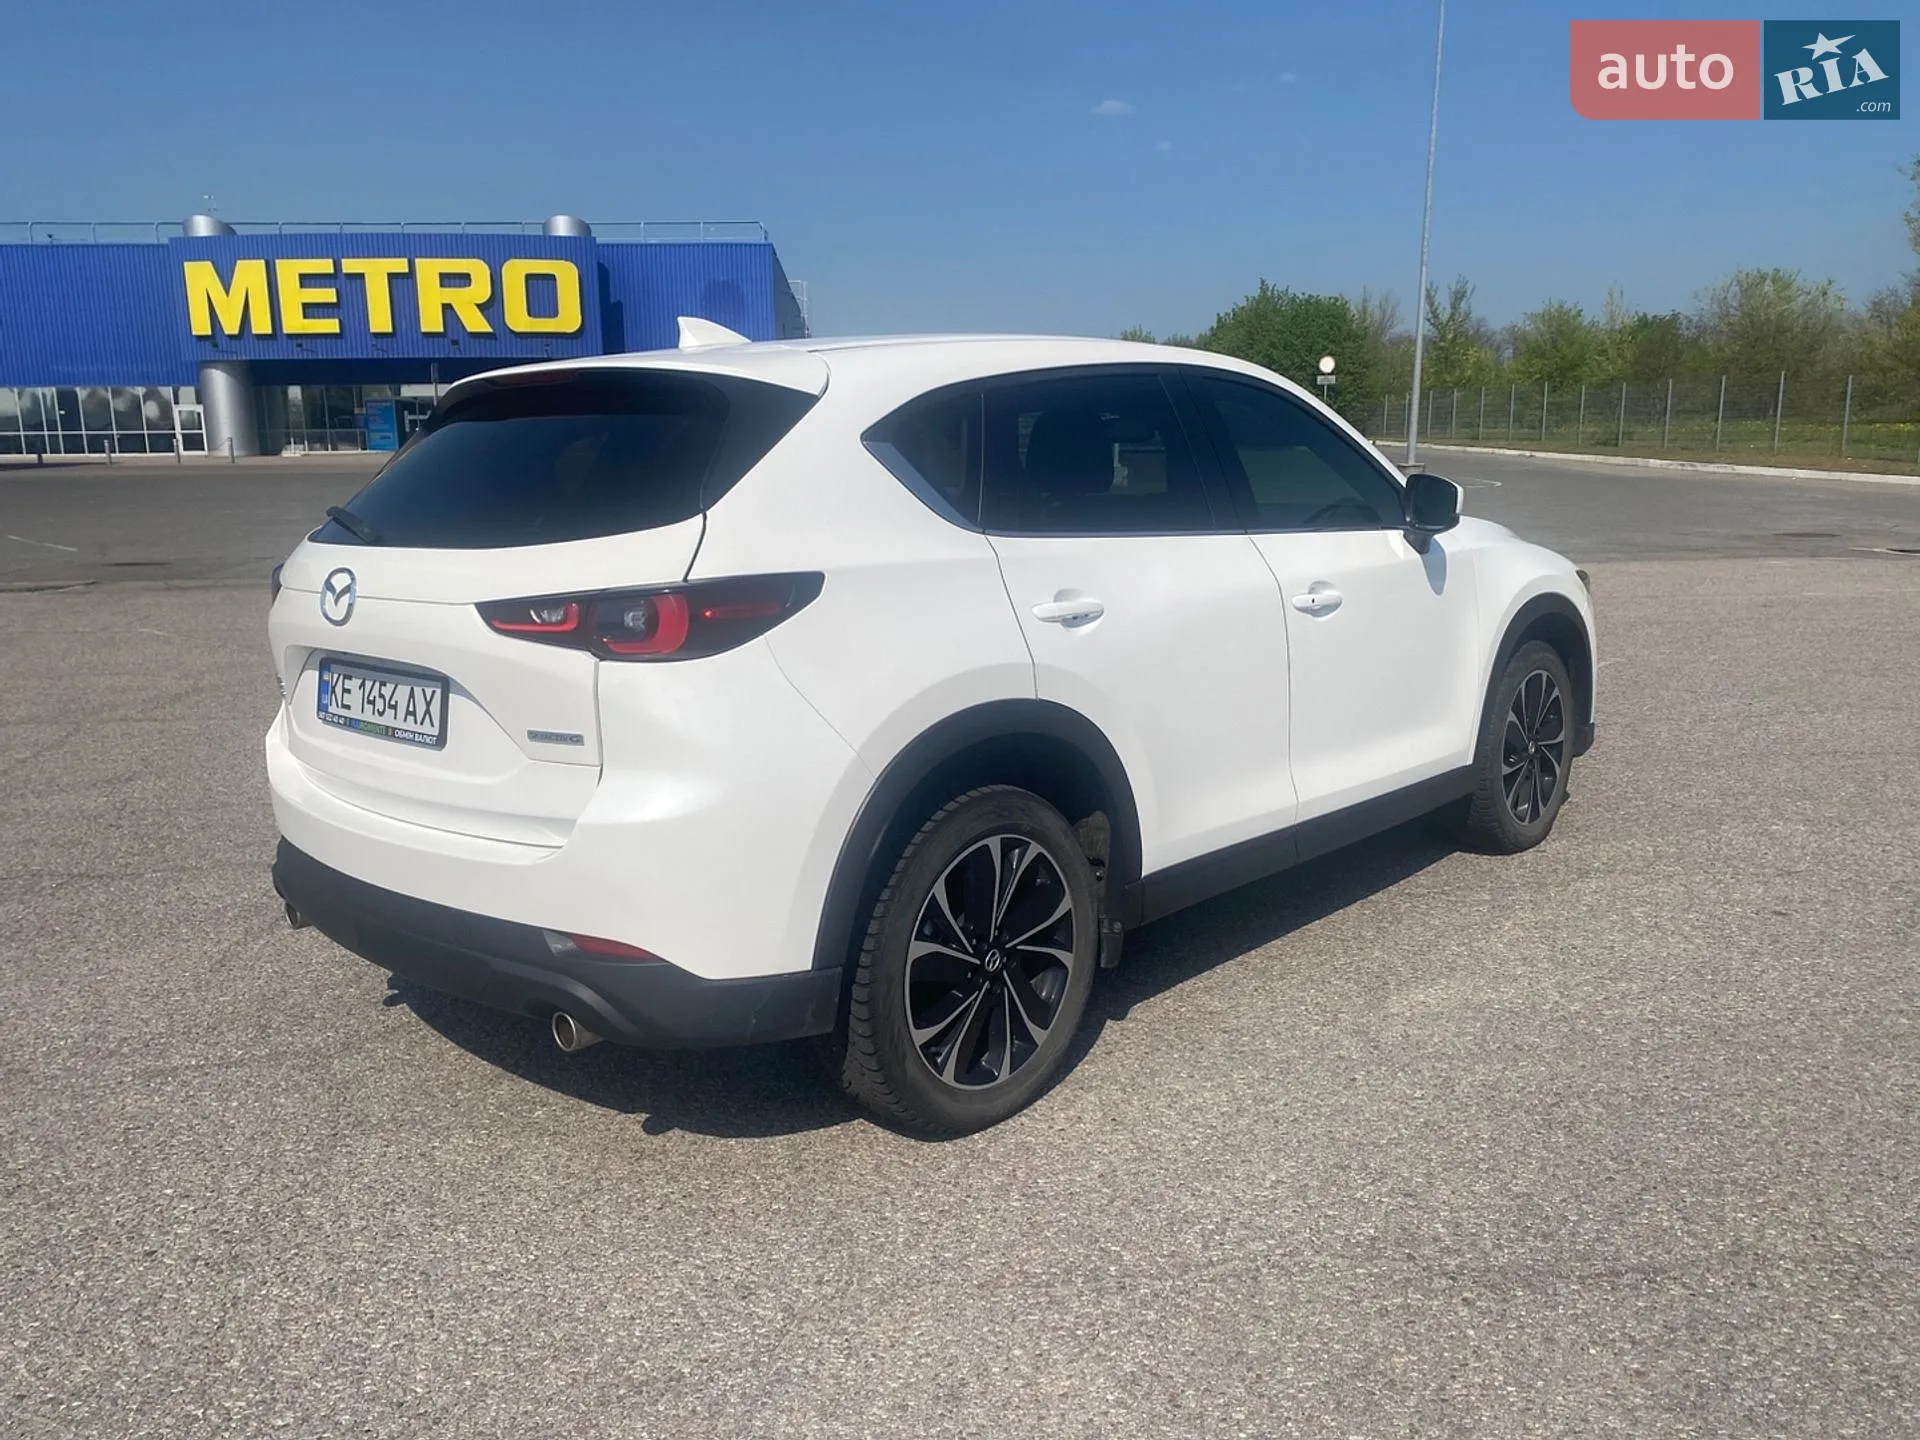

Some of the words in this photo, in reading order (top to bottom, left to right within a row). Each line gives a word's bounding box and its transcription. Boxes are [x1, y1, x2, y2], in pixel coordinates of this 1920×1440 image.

[183, 258, 583, 337] METRO
[330, 672, 352, 710] KE
[358, 679, 399, 721] 1454
[403, 686, 436, 728] AX
